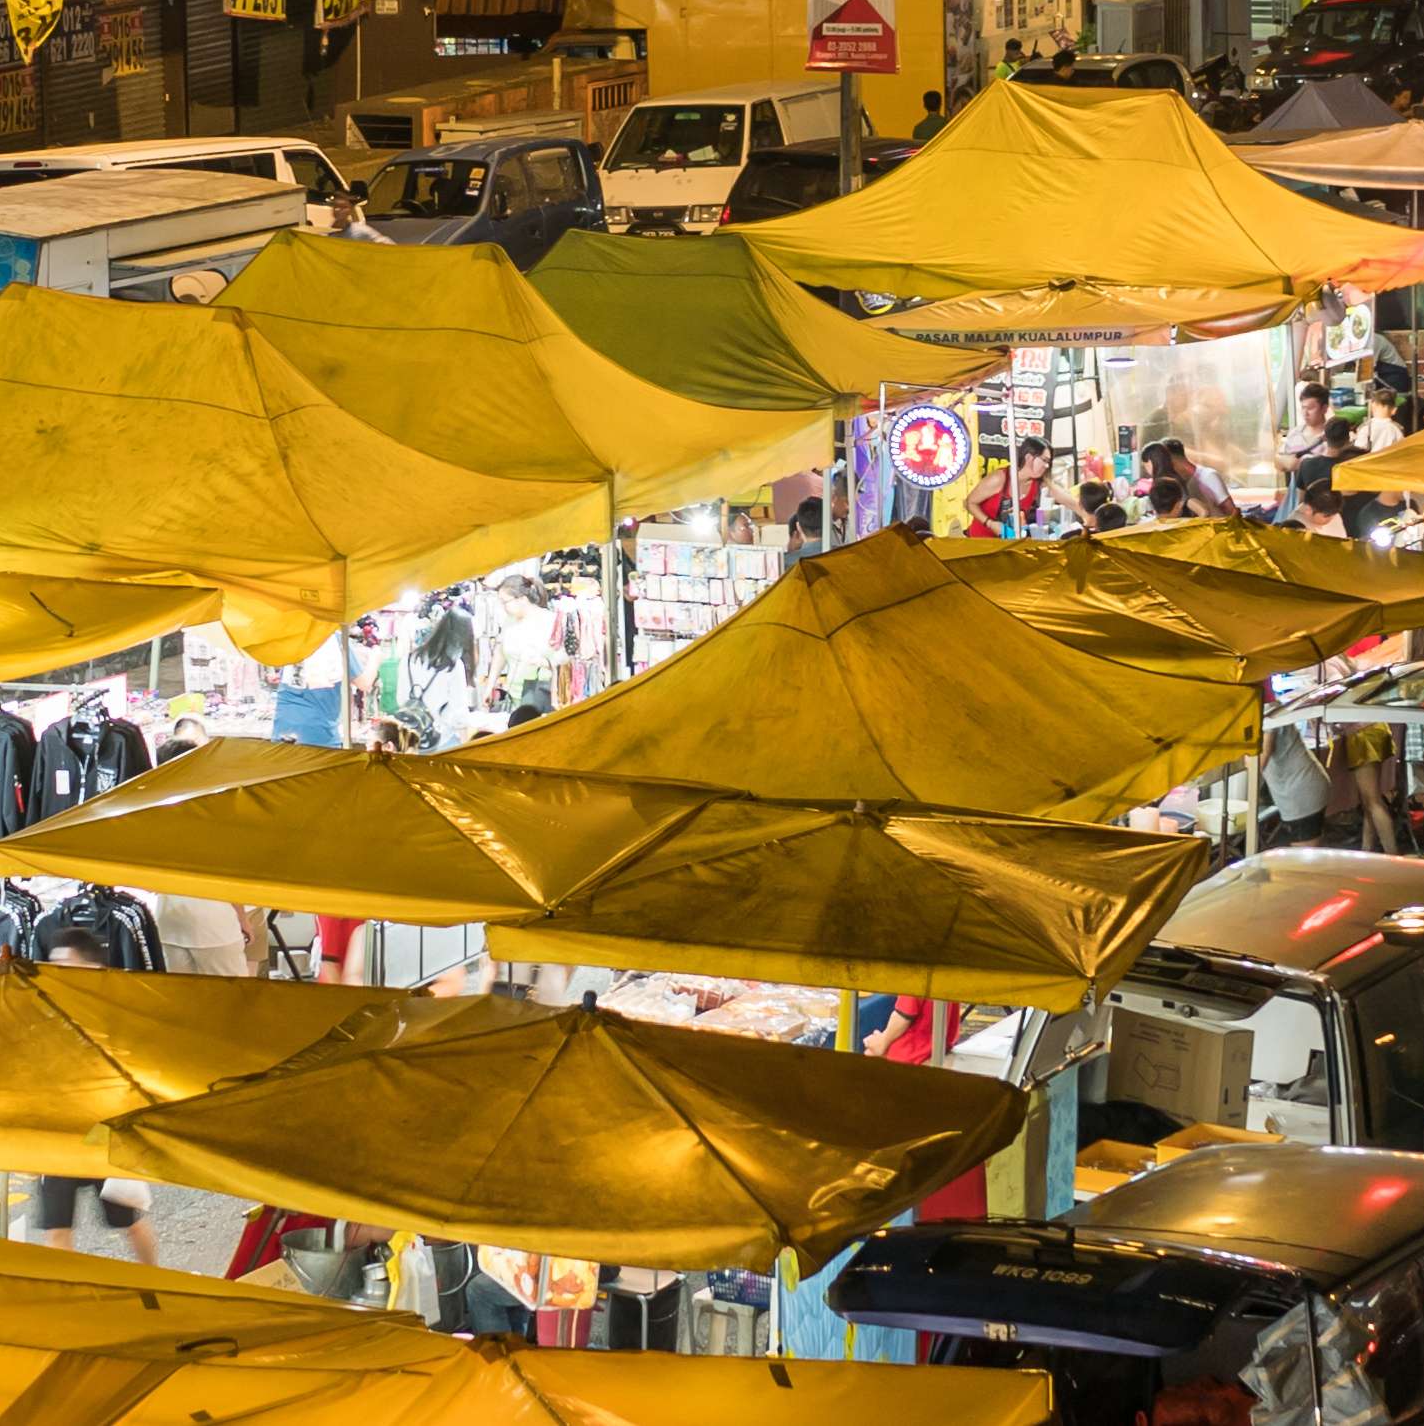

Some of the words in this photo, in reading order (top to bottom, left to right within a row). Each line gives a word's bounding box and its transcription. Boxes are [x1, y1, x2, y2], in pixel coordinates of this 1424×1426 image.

[915, 333, 960, 344] PASAR
[963, 332, 1015, 343] MALAM
[1018, 331, 1123, 343] KUALALUMPUR
